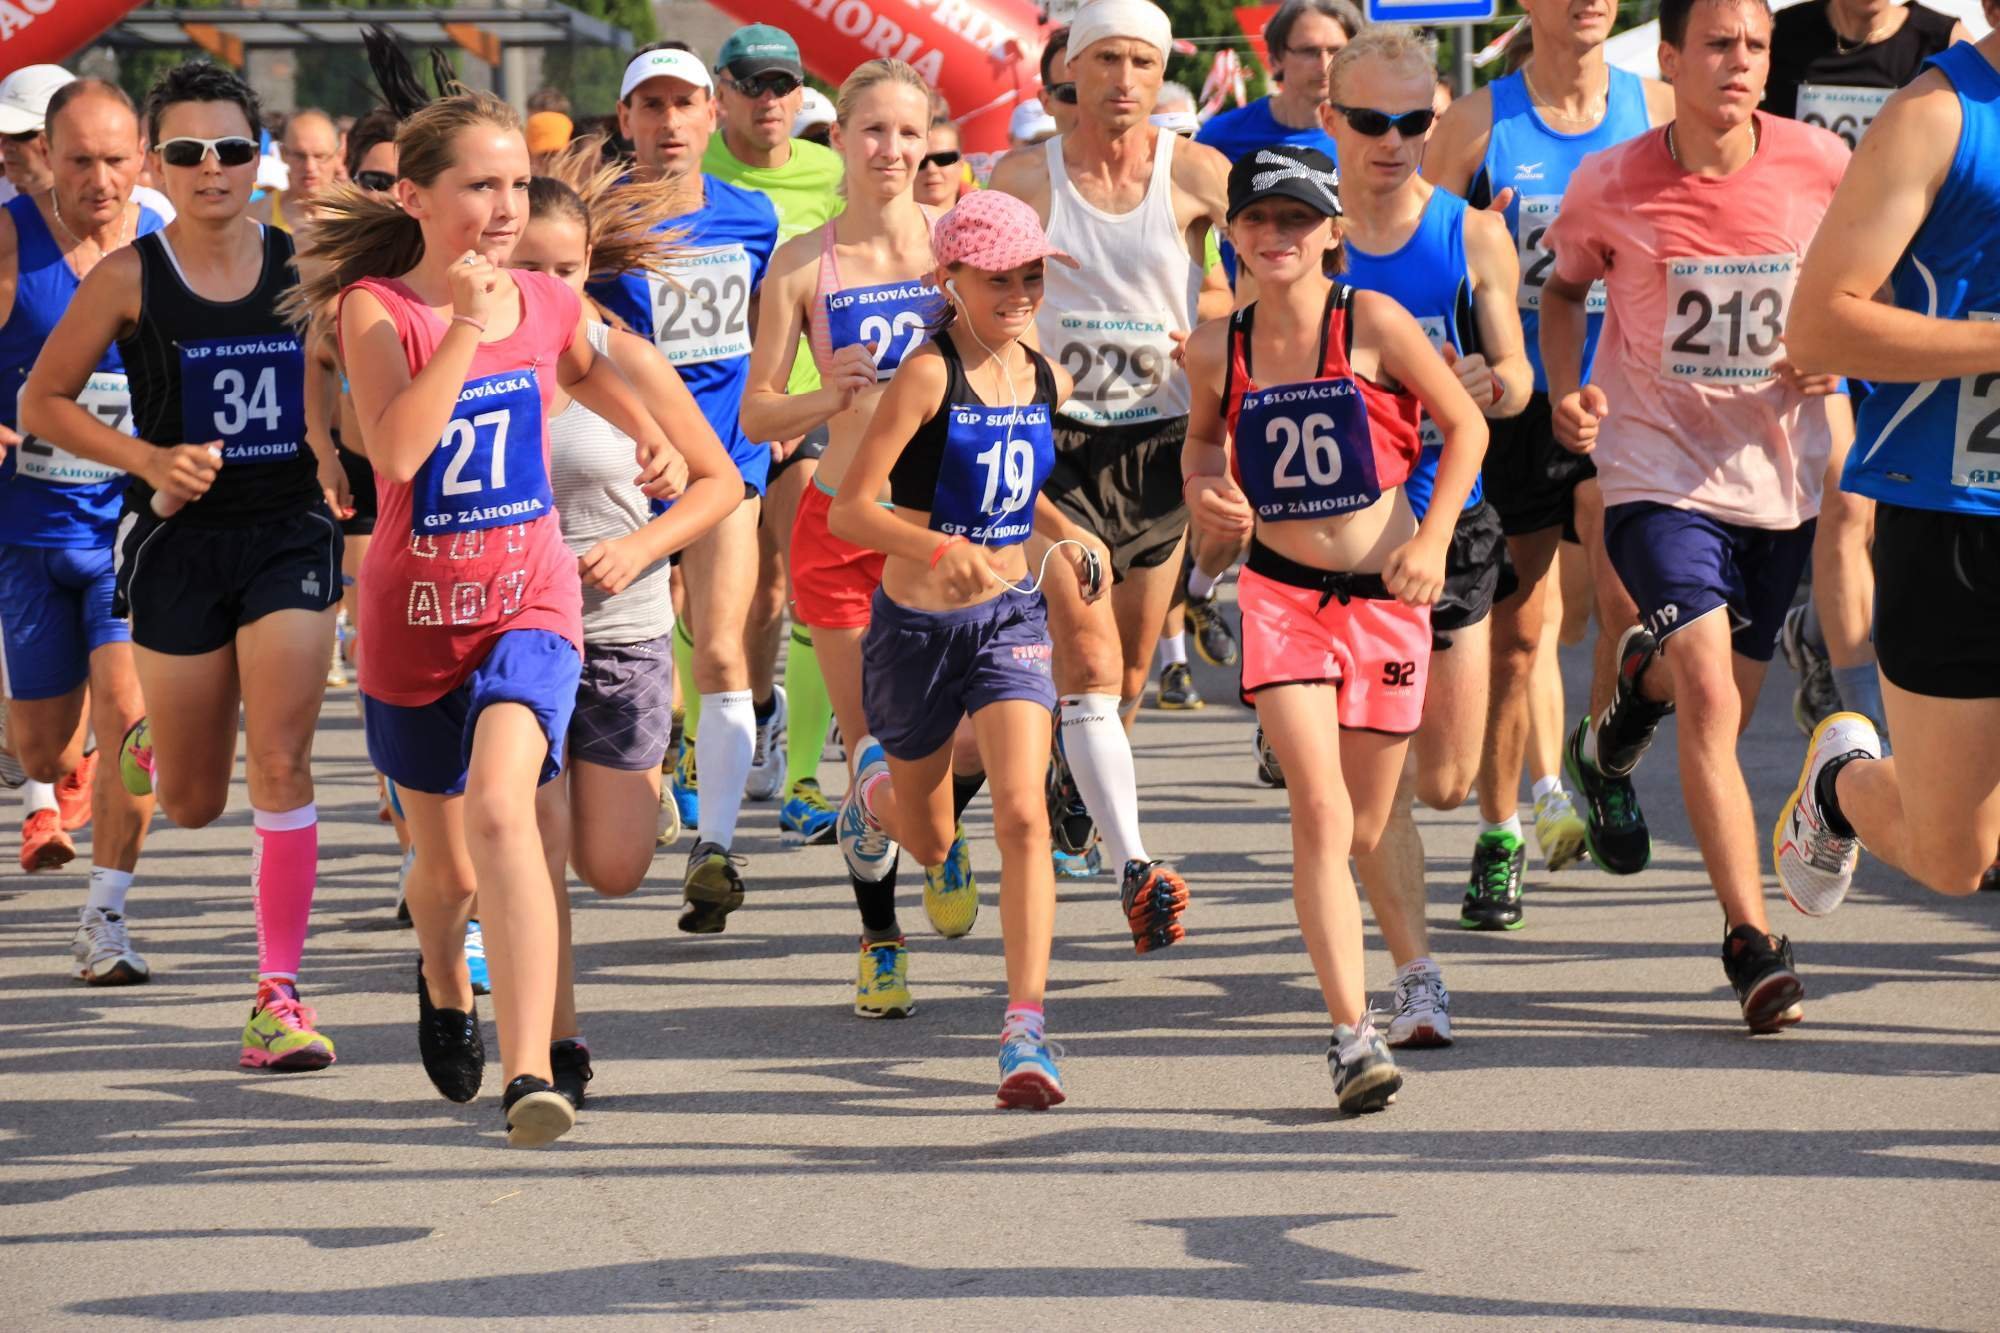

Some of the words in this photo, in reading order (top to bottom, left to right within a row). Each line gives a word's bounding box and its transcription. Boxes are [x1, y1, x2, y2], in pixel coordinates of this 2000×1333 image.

[1527, 203, 1549, 213] GP
[1673, 264, 1698, 276] GP
[1703, 262, 1791, 275] SLOVÁCKA
[831, 296, 855, 309] GP
[859, 284, 943, 305] SLOVÁCKA
[658, 275, 747, 342] 232
[1062, 319, 1082, 329] GP
[1087, 320, 1164, 332] SLOVÁCKA
[1671, 287, 1783, 357] 213
[186, 347, 211, 359] GP
[215, 340, 298, 356] SLOVÁCKA
[859, 310, 925, 368] 22
[668, 351, 688, 361] GP
[692, 342, 745, 358] ZÁHORIA
[1060, 342, 1165, 401] 229
[1672, 364, 1697, 375] GP
[212, 366, 283, 436] 34
[1263, 385, 1357, 406] SLOVÁCKA
[956, 412, 981, 425] GP
[1094, 405, 1158, 421] ZÁHORIA
[225, 442, 298, 458] ZÁHORIA
[440, 408, 511, 497] 27
[1265, 412, 1343, 489] 26
[25, 463, 46, 473] GP
[975, 439, 1035, 513] 19
[1969, 469, 2000, 483] GP
[423, 512, 453, 527] GP
[458, 497, 545, 523] ZÁHORIA
[1258, 503, 1284, 517] GP
[1288, 493, 1370, 514] ZÁHORIA
[940, 522, 968, 535] GP
[971, 521, 1031, 539] ZÁHORIA
[1382, 661, 1416, 687] 92
